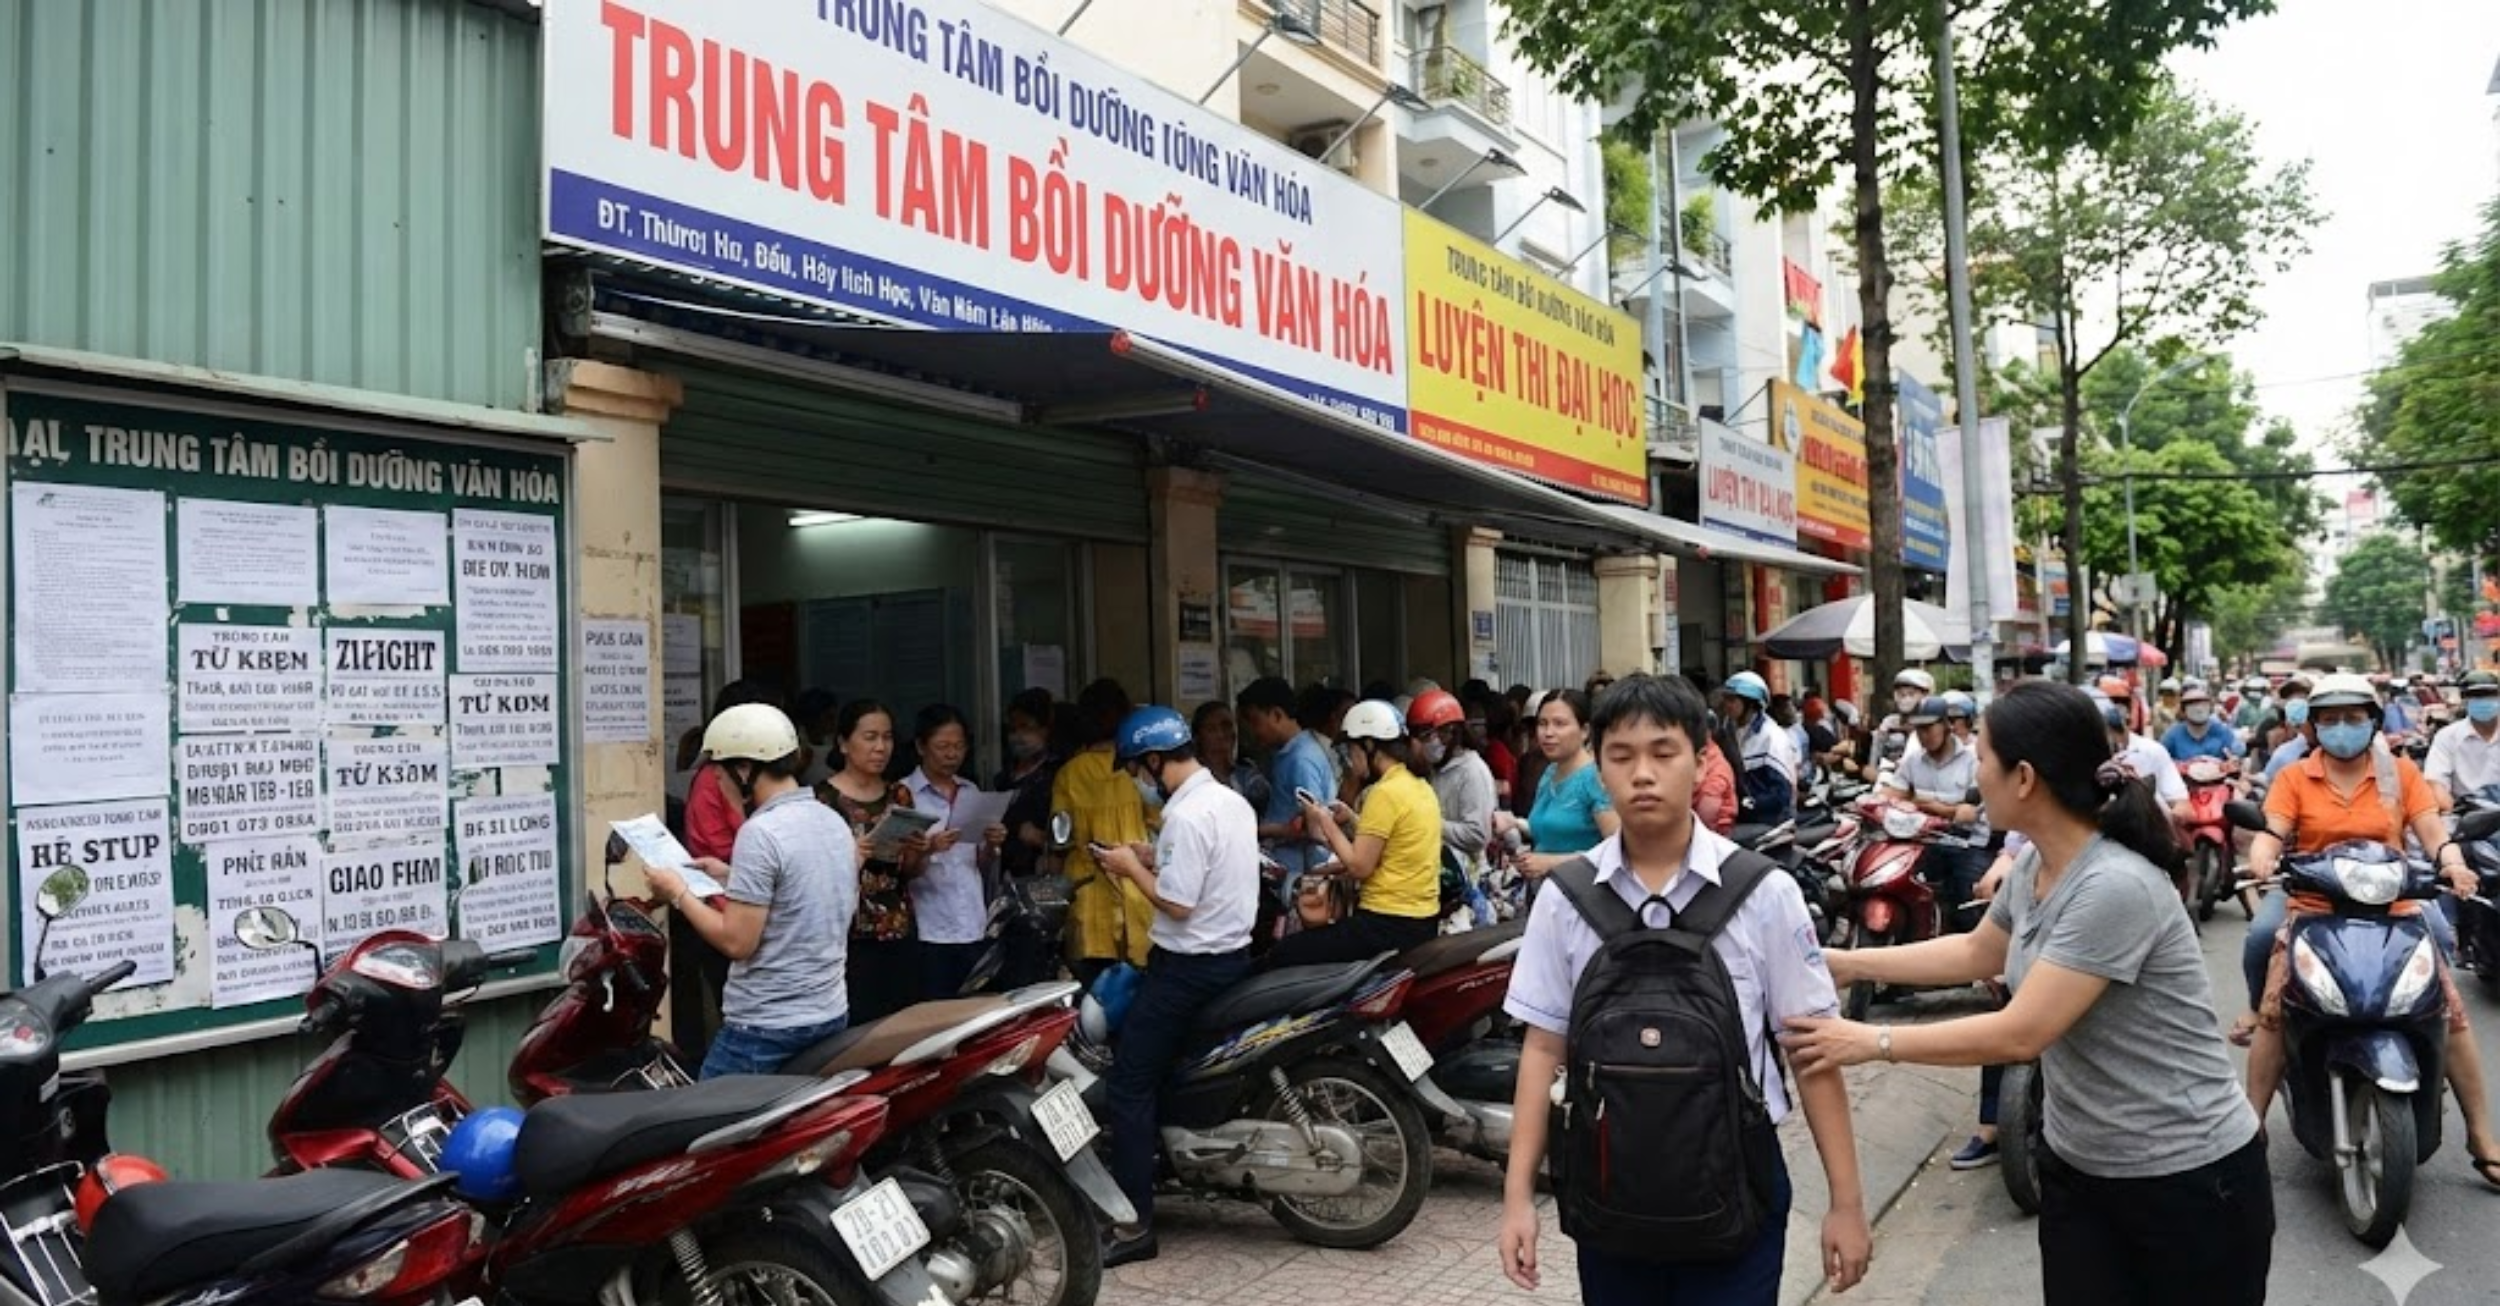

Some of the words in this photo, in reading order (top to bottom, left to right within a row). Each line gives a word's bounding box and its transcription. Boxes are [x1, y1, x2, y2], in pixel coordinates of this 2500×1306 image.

[938, 19, 1004, 96] TÂM
[601, 2, 846, 207] TRUNG
[866, 92, 990, 251] TÂM
[1009, 136, 1088, 282] BỒI
[1104, 191, 1243, 329] DƯỠNG
[1252, 238, 1322, 354] VĂN
[1333, 270, 1393, 376] HÓA
[1418, 290, 1506, 403] LUYỆN
[1513, 331, 1550, 410] THI
[1556, 350, 1593, 436] ĐẠI
[1599, 366, 1638, 449] HỌC
[84, 424, 200, 473] TRUNG
[209, 432, 280, 480] TÂM
[450, 459, 501, 499] VĂN
[510, 464, 560, 504] HÓA
[83, 834, 160, 864] STUP
